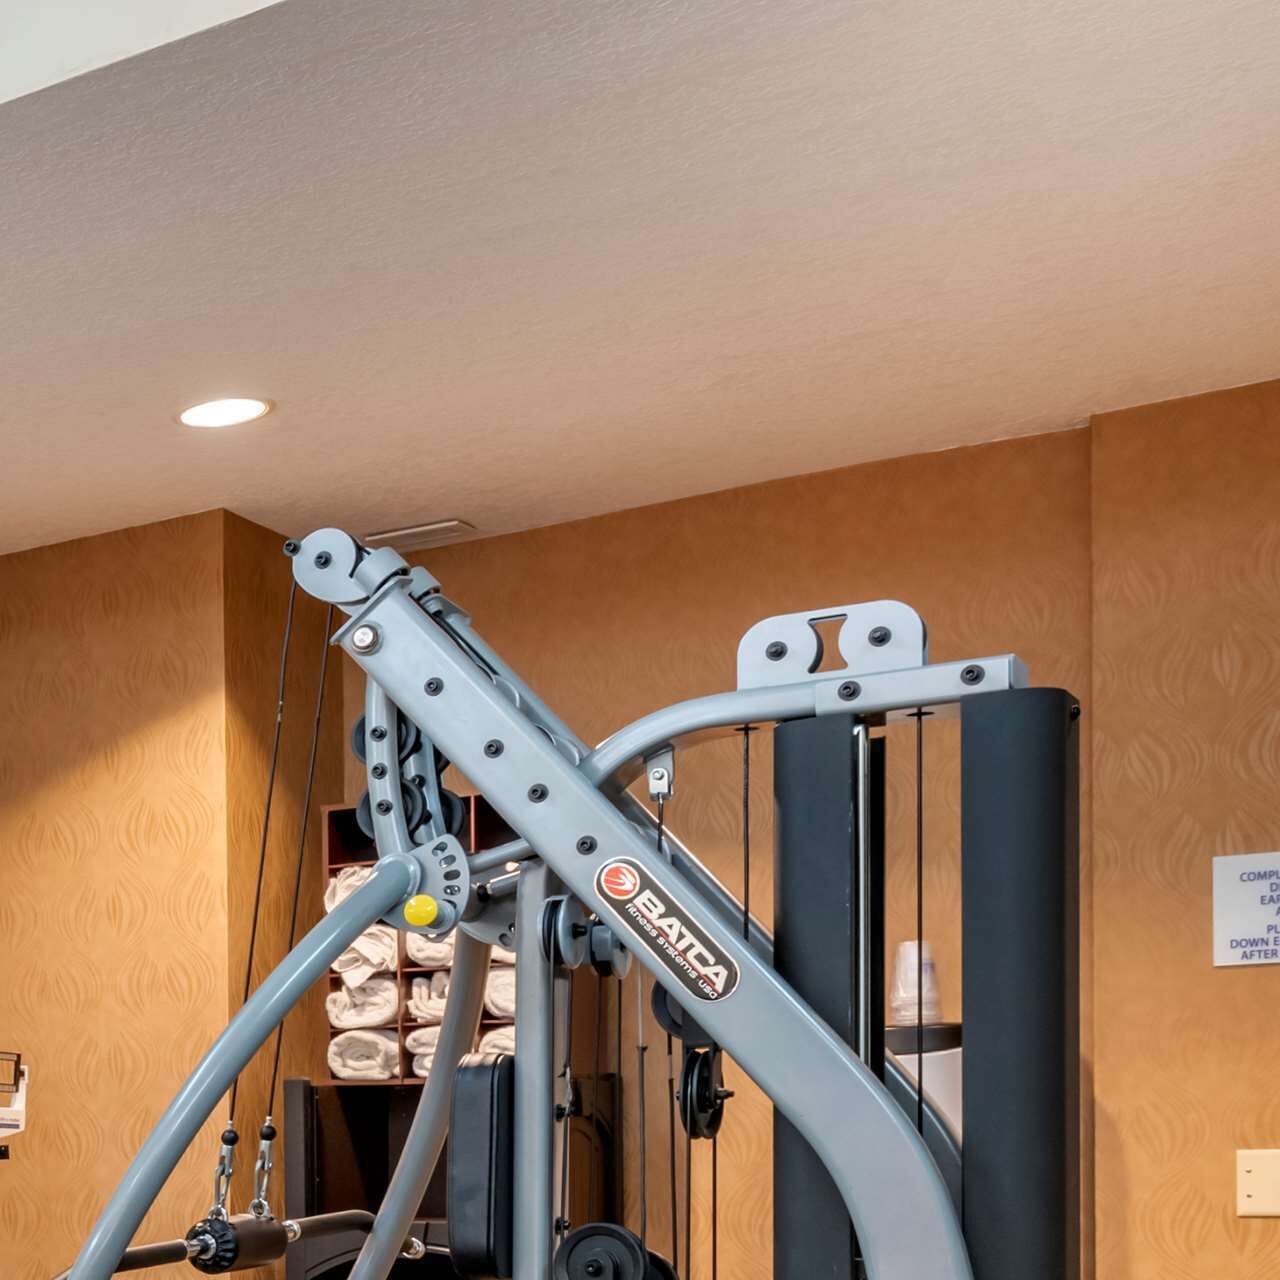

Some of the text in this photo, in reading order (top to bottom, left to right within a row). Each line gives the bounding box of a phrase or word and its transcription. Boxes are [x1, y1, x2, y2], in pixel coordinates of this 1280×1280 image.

[633, 889, 729, 994] BATCA
[1230, 937, 1269, 949] DOWN
[1241, 949, 1279, 960] AFTER
